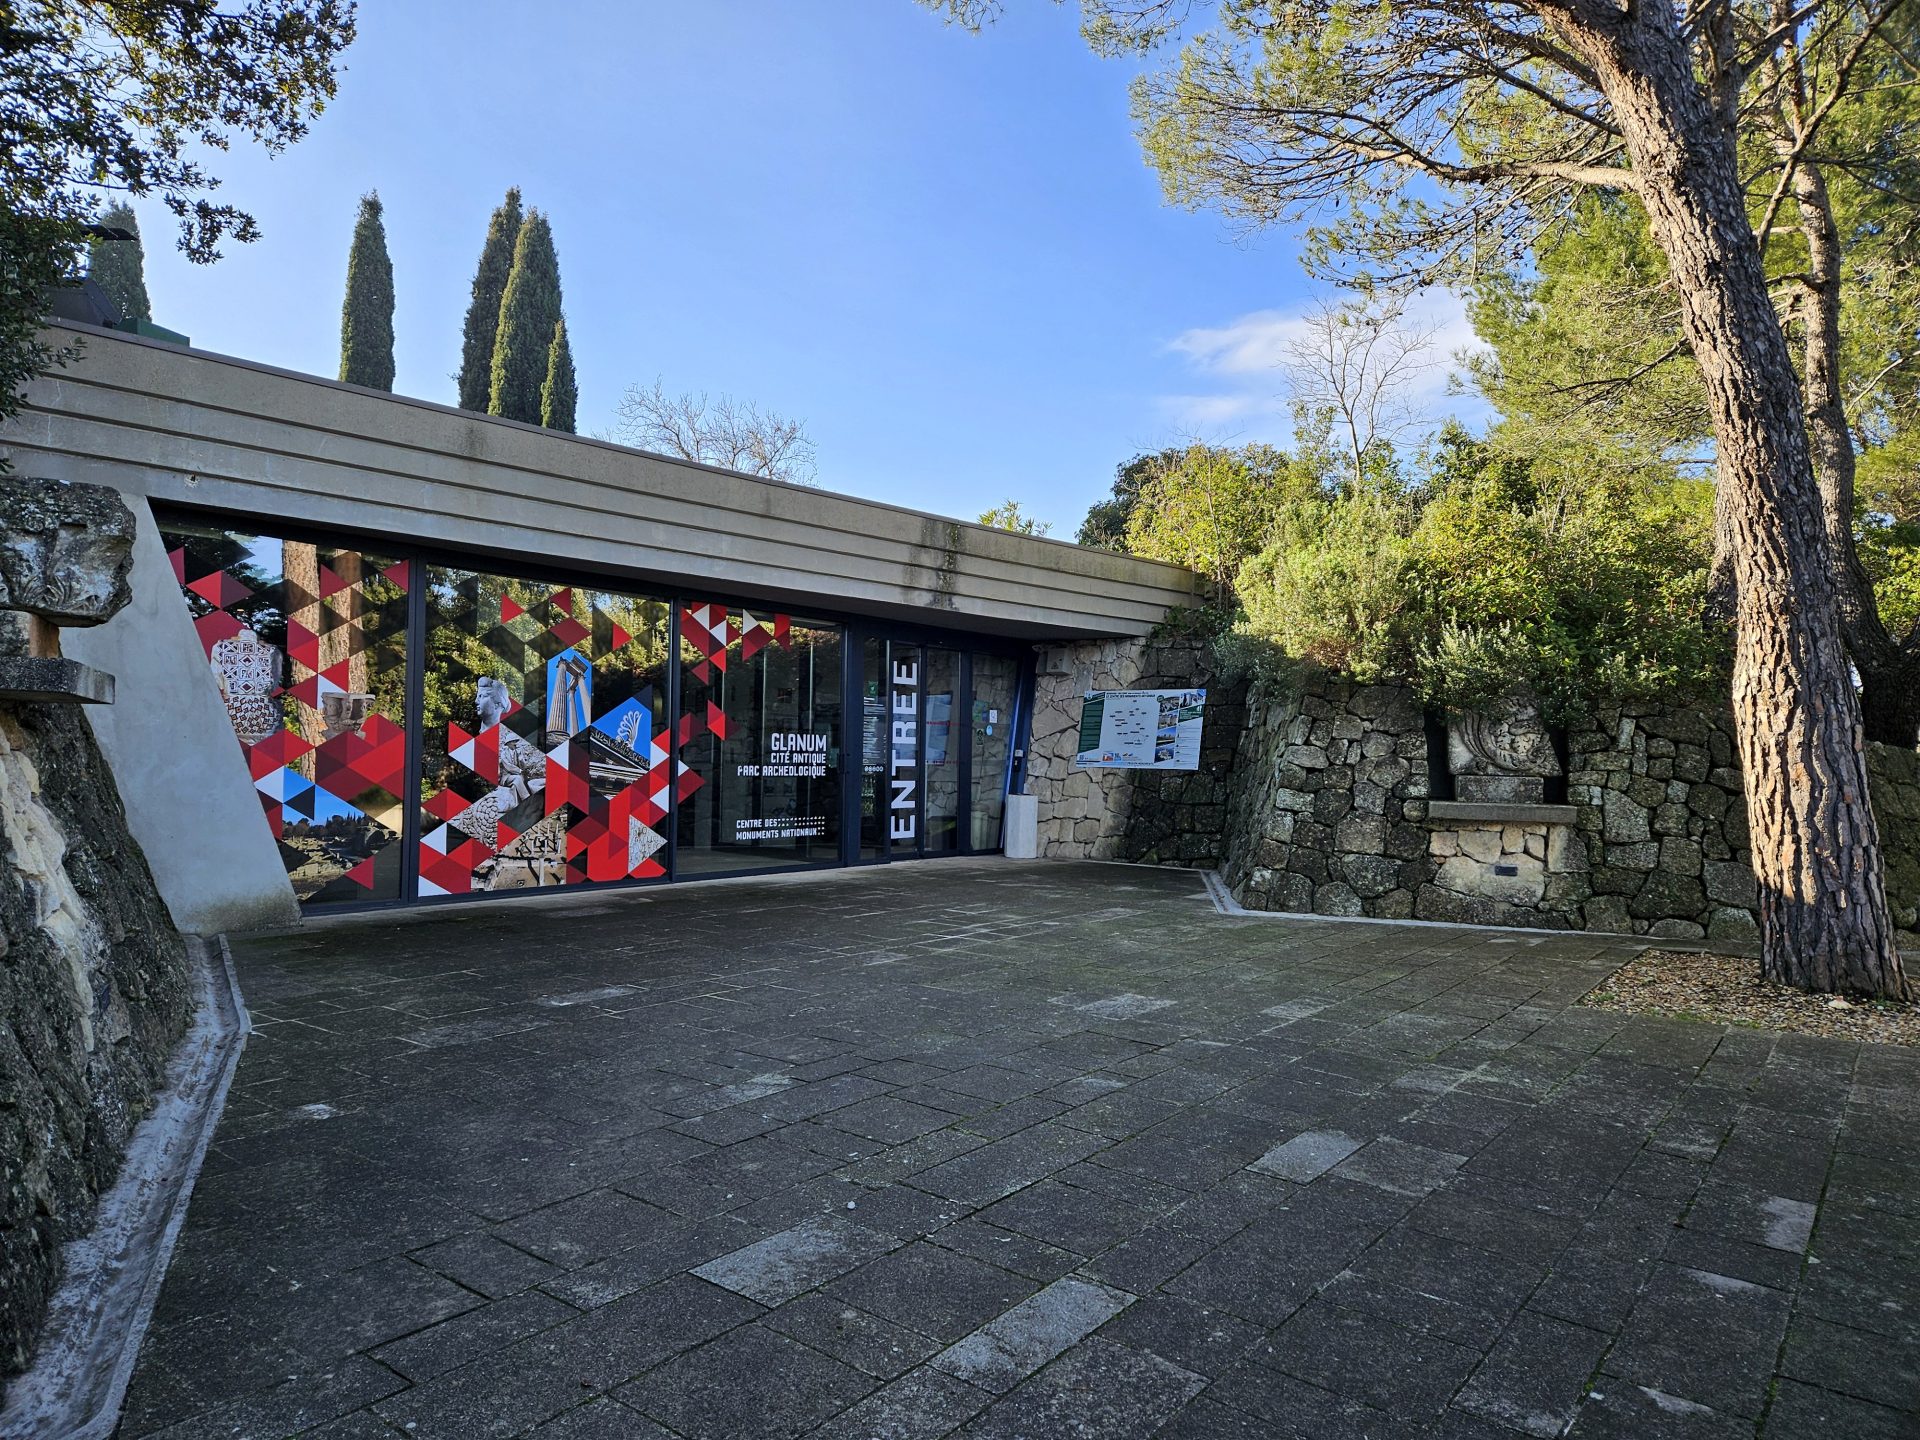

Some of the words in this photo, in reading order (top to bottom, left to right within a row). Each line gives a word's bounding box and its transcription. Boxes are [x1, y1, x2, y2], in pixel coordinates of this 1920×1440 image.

[771, 733, 827, 752] GLANUM
[891, 661, 917, 839] ENTREE
[771, 750, 790, 764] CITÉ
[793, 752, 827, 766] ANTIQUE
[737, 765, 760, 777] PARC
[762, 765, 827, 779] ARCHEOLOGIQUE
[736, 819, 763, 829] CENTRE
[765, 818, 778, 827] DES
[736, 829, 779, 841] MONUMENTS
[781, 827, 817, 838] NATIONAUX
